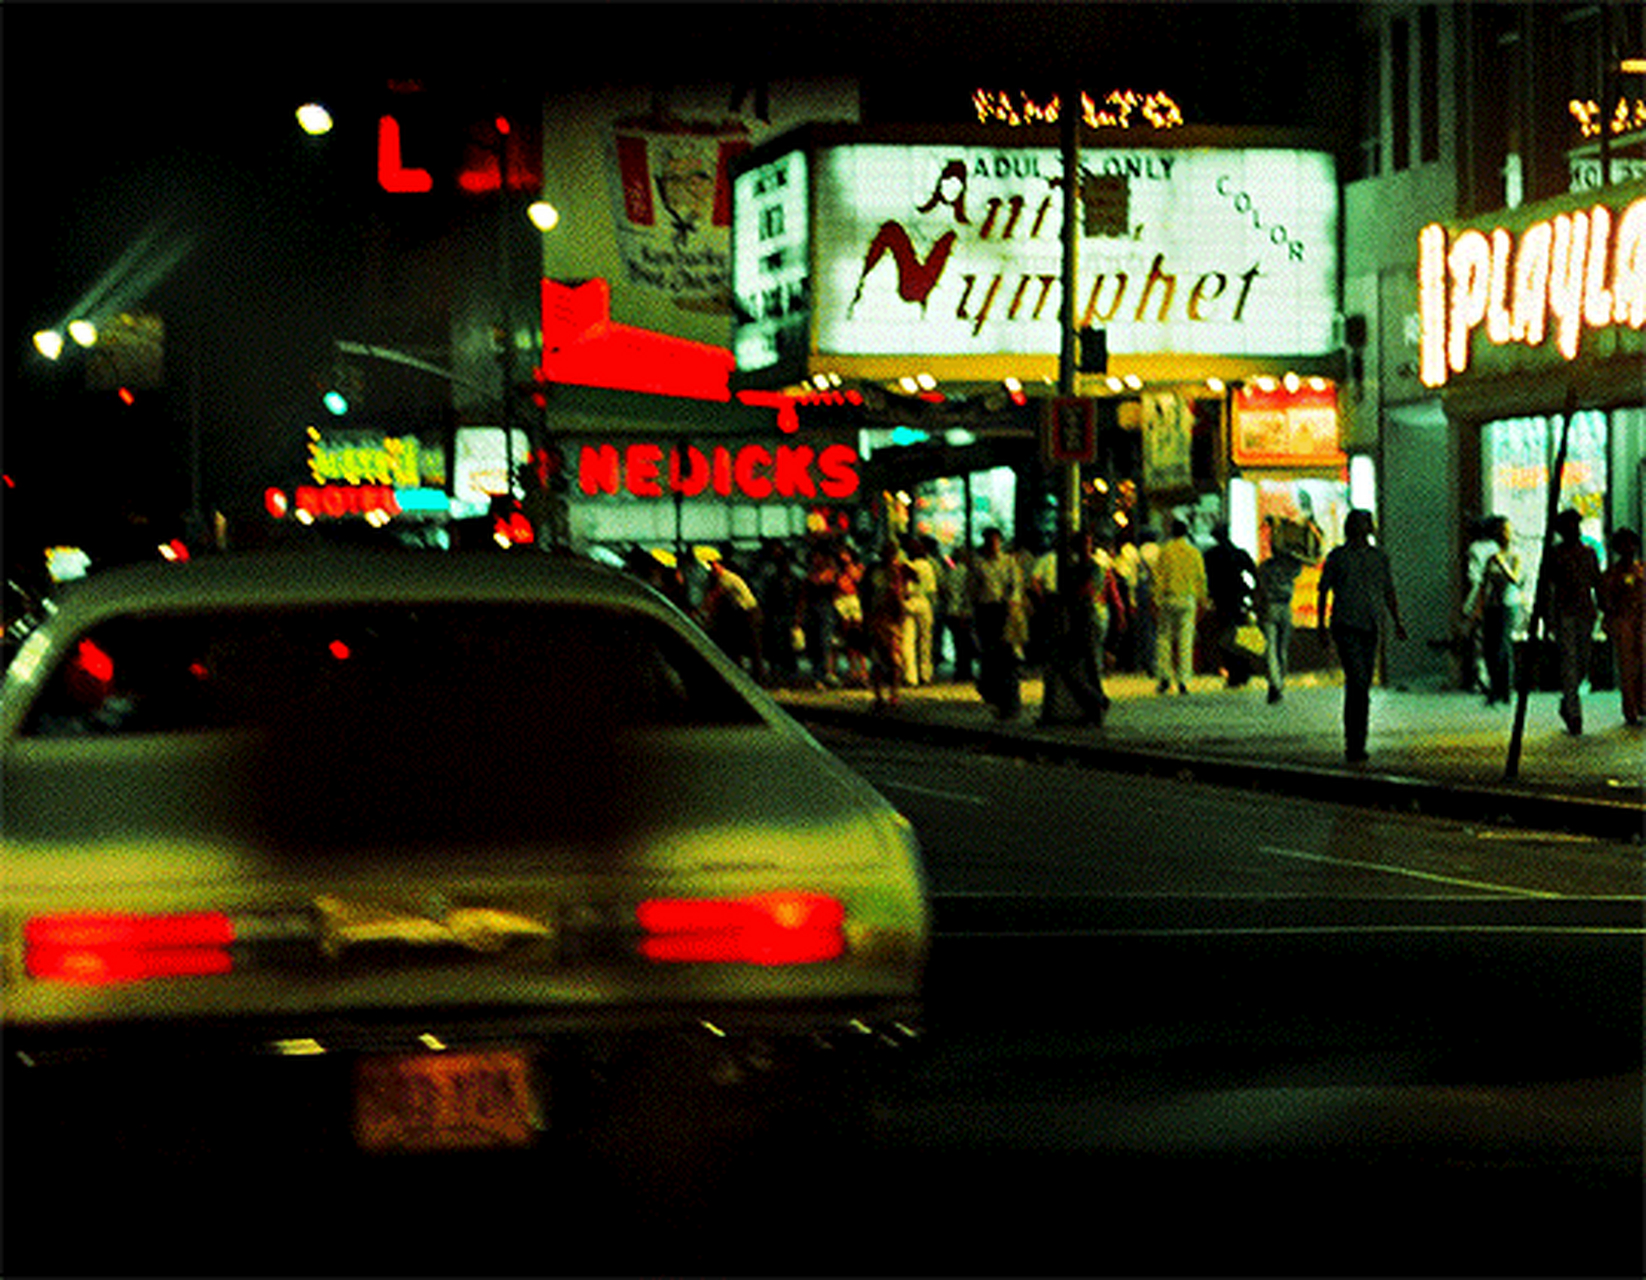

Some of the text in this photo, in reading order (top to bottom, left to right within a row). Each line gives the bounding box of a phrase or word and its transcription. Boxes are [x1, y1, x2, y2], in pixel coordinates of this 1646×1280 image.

[1103, 156, 1175, 179] ONLY
[1216, 175, 1304, 262] COLOR
[848, 219, 1260, 337] Nymphet
[579, 444, 859, 498] NEDICKS
